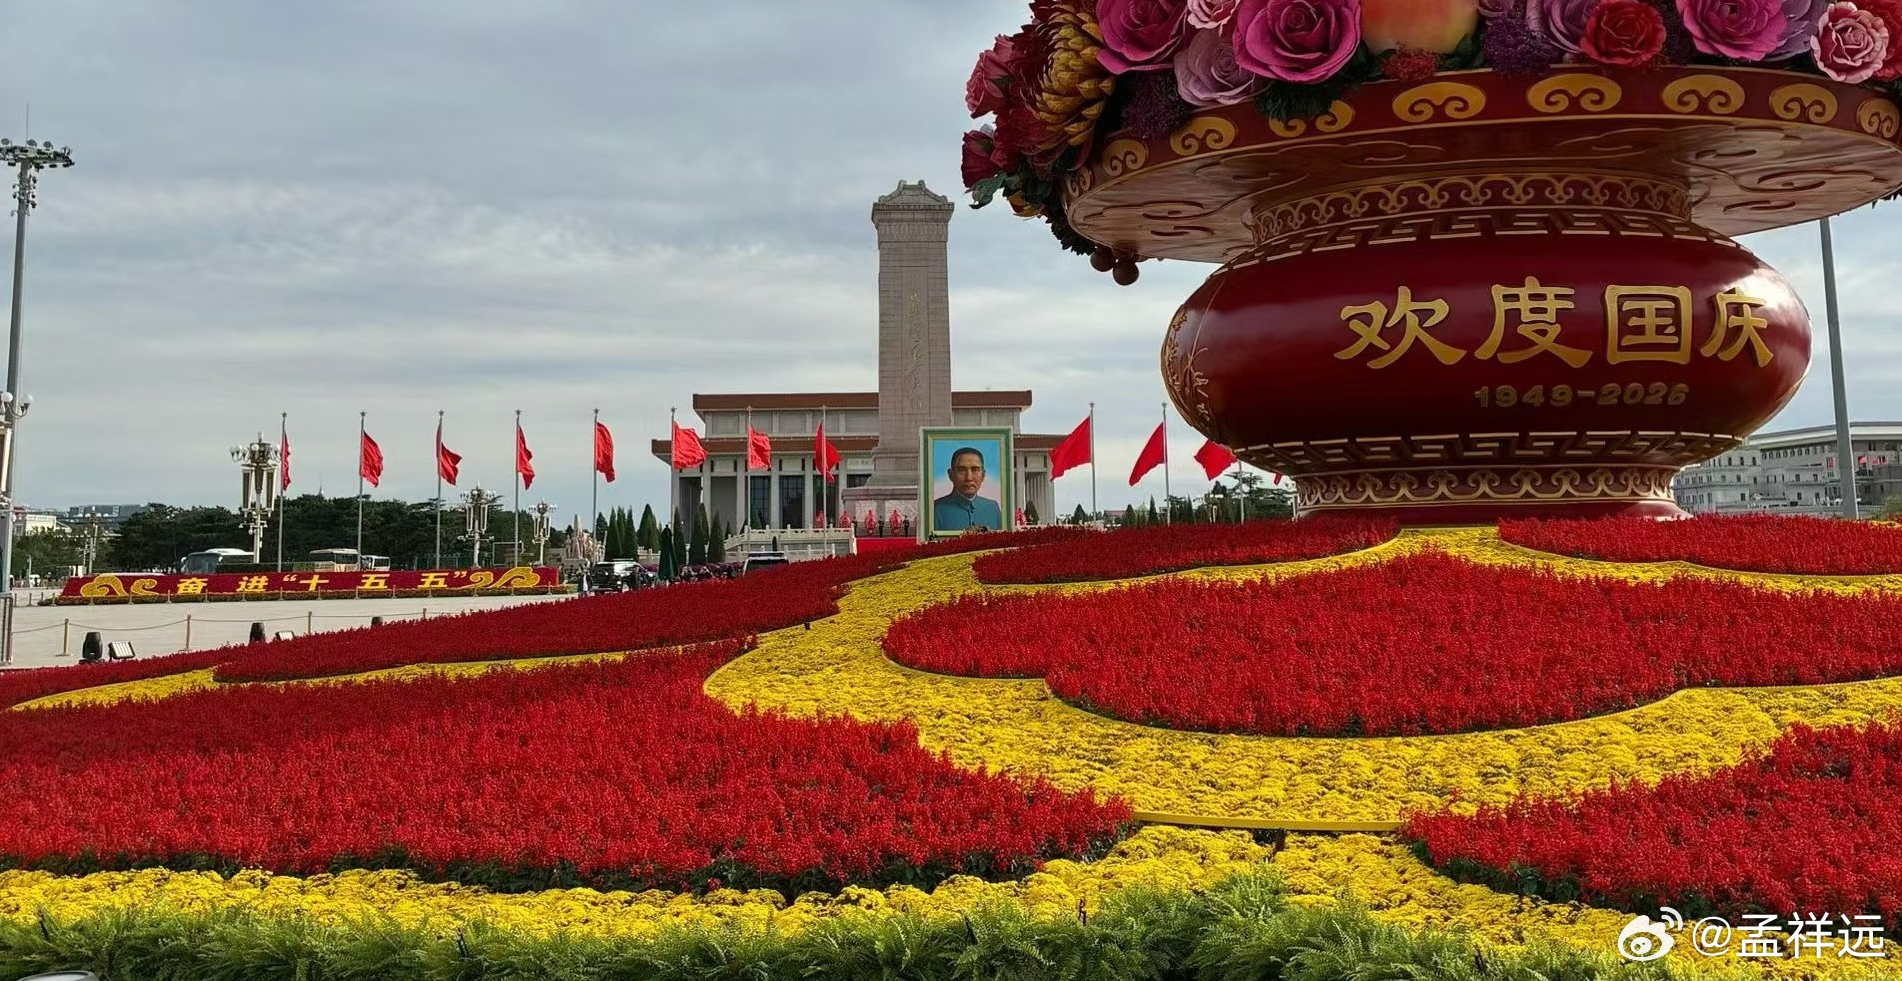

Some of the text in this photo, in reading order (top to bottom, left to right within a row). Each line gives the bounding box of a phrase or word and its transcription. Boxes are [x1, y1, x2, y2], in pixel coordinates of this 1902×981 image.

[1333, 276, 1774, 368] 欢度国庆
[1475, 382, 1689, 407] 1949-2026
